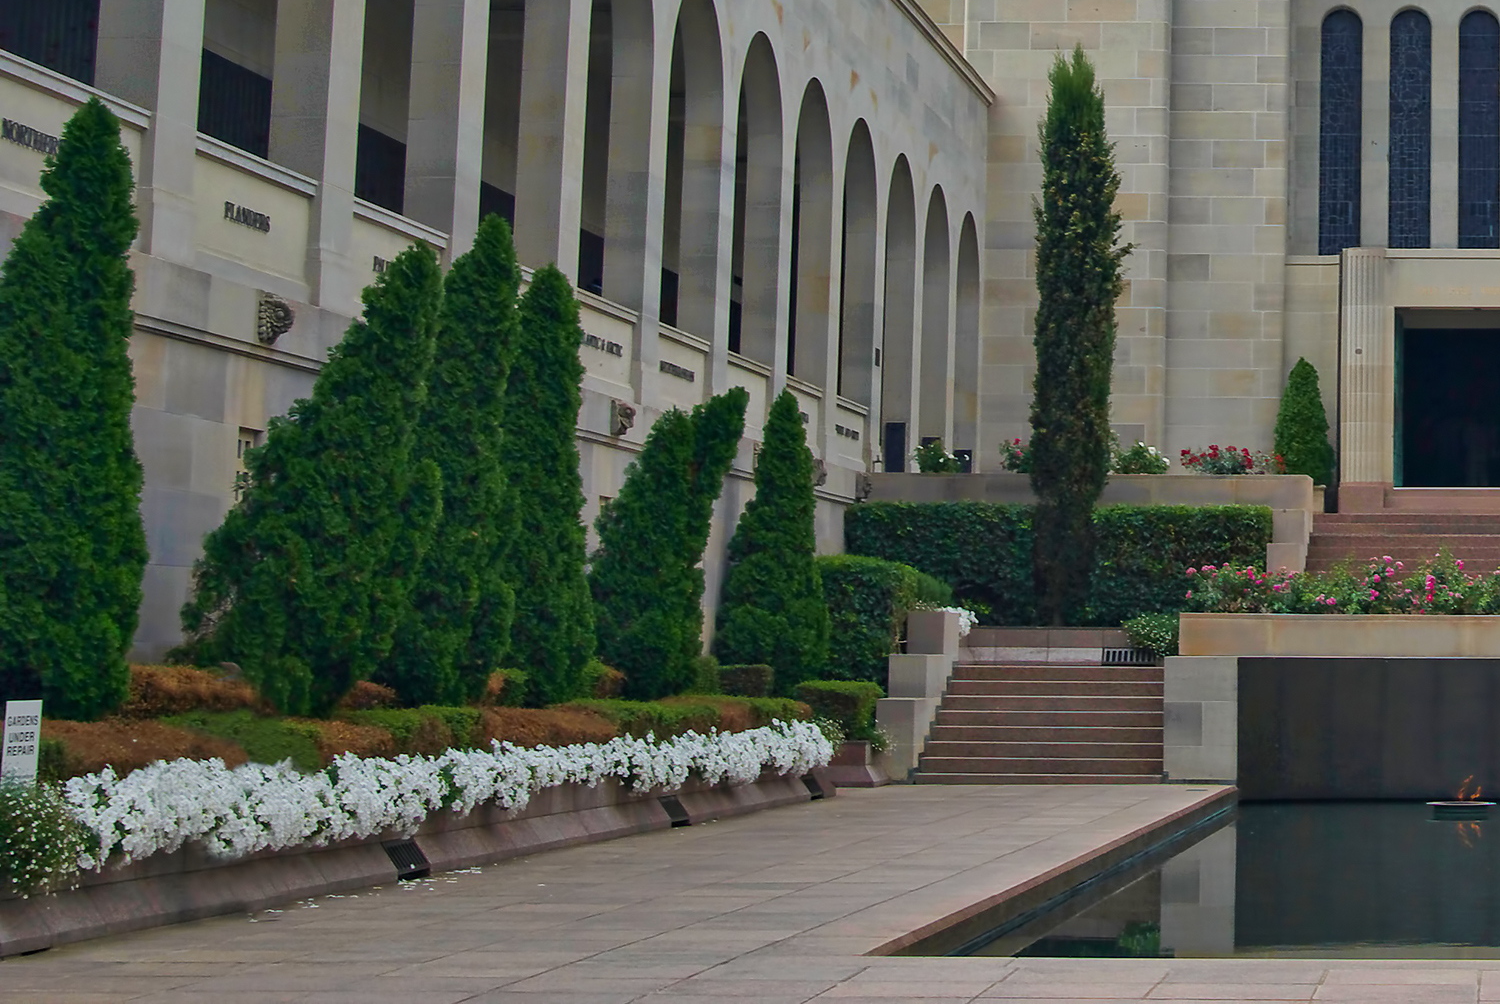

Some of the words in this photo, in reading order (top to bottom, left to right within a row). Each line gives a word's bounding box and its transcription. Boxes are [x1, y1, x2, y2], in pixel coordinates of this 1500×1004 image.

[2, 117, 60, 155] NORTHER
[224, 200, 271, 234] FLANDERS
[8, 715, 39, 727] GARDENS
[9, 731, 35, 743] UNDER
[7, 745, 35, 757] REPAIR
